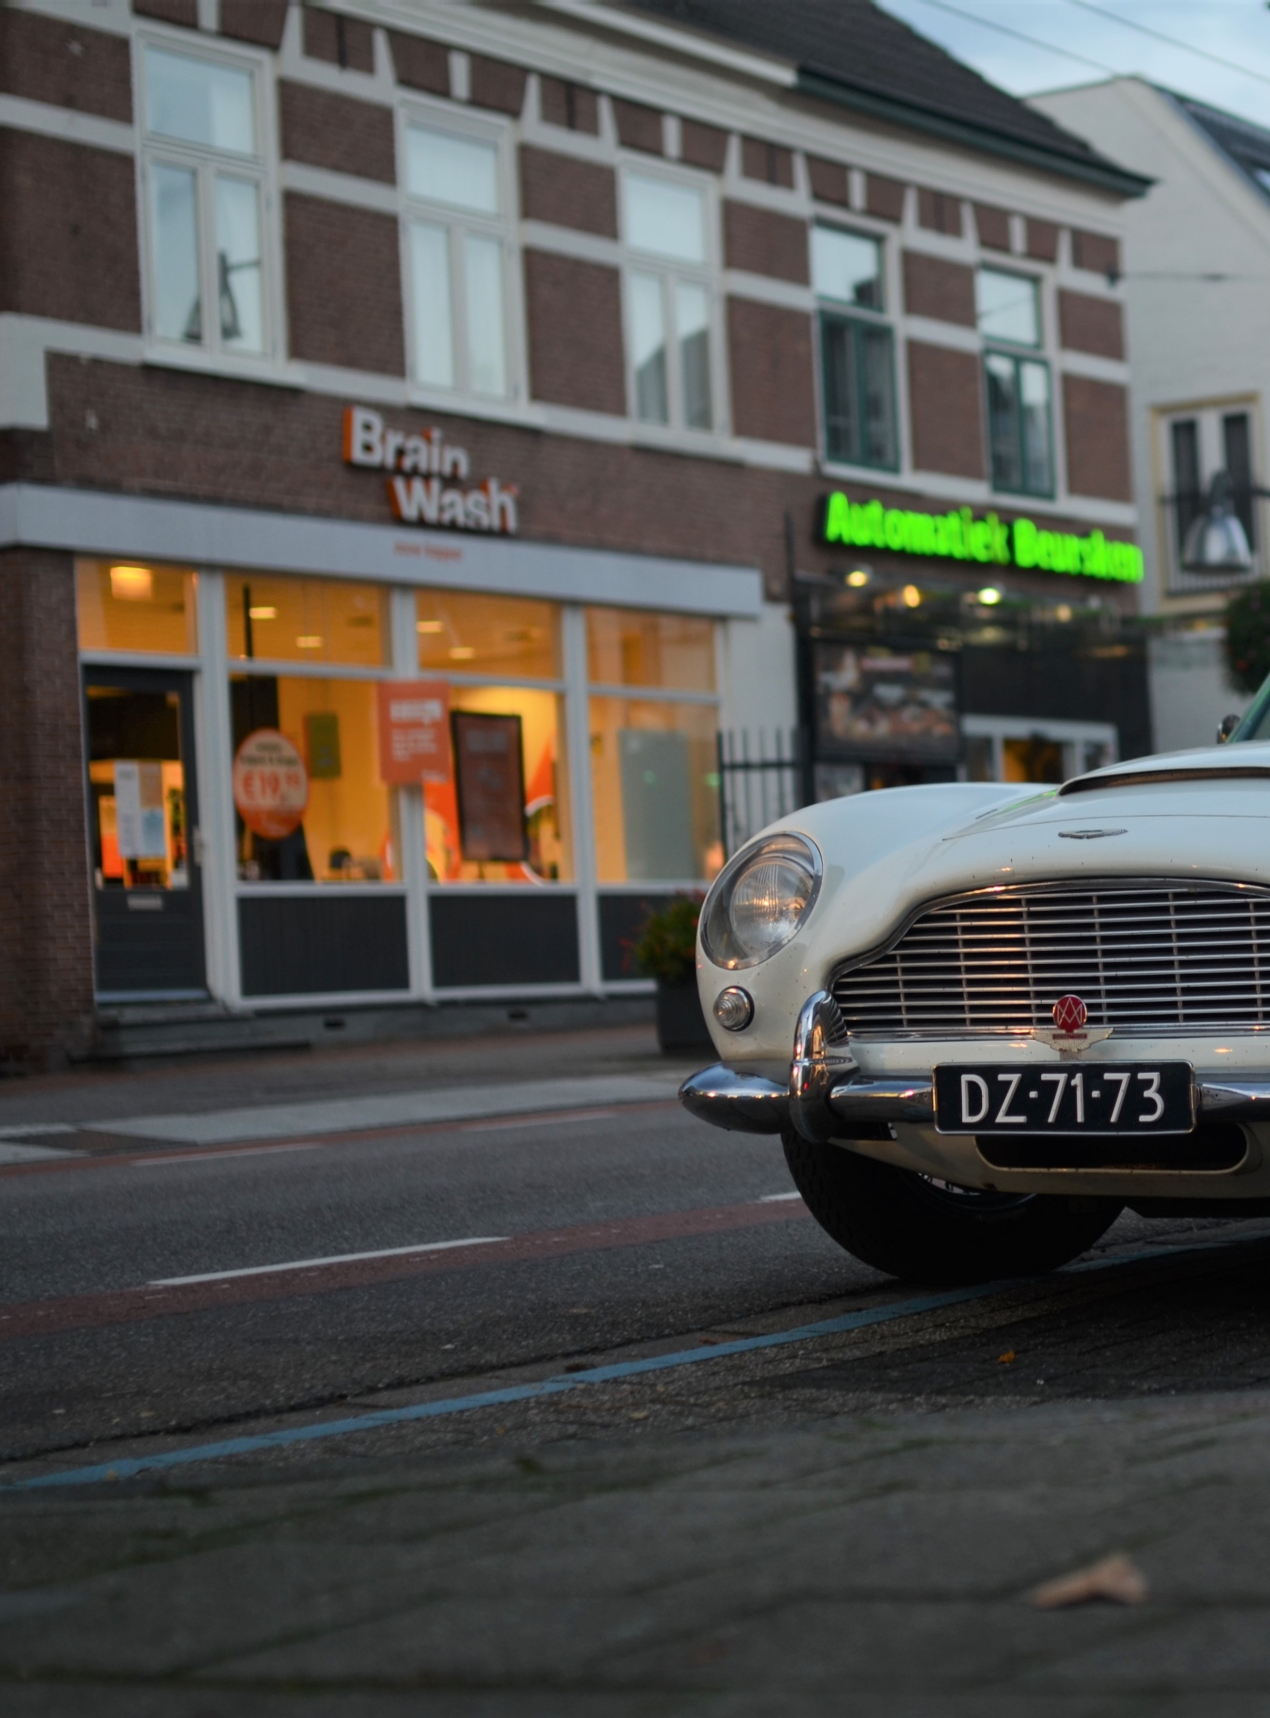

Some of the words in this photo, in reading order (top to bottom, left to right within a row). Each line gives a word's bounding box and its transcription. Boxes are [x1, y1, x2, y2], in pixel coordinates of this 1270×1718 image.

[345, 405, 469, 479] Brain
[389, 476, 518, 534] Wash
[826, 491, 1010, 566] Automatiek
